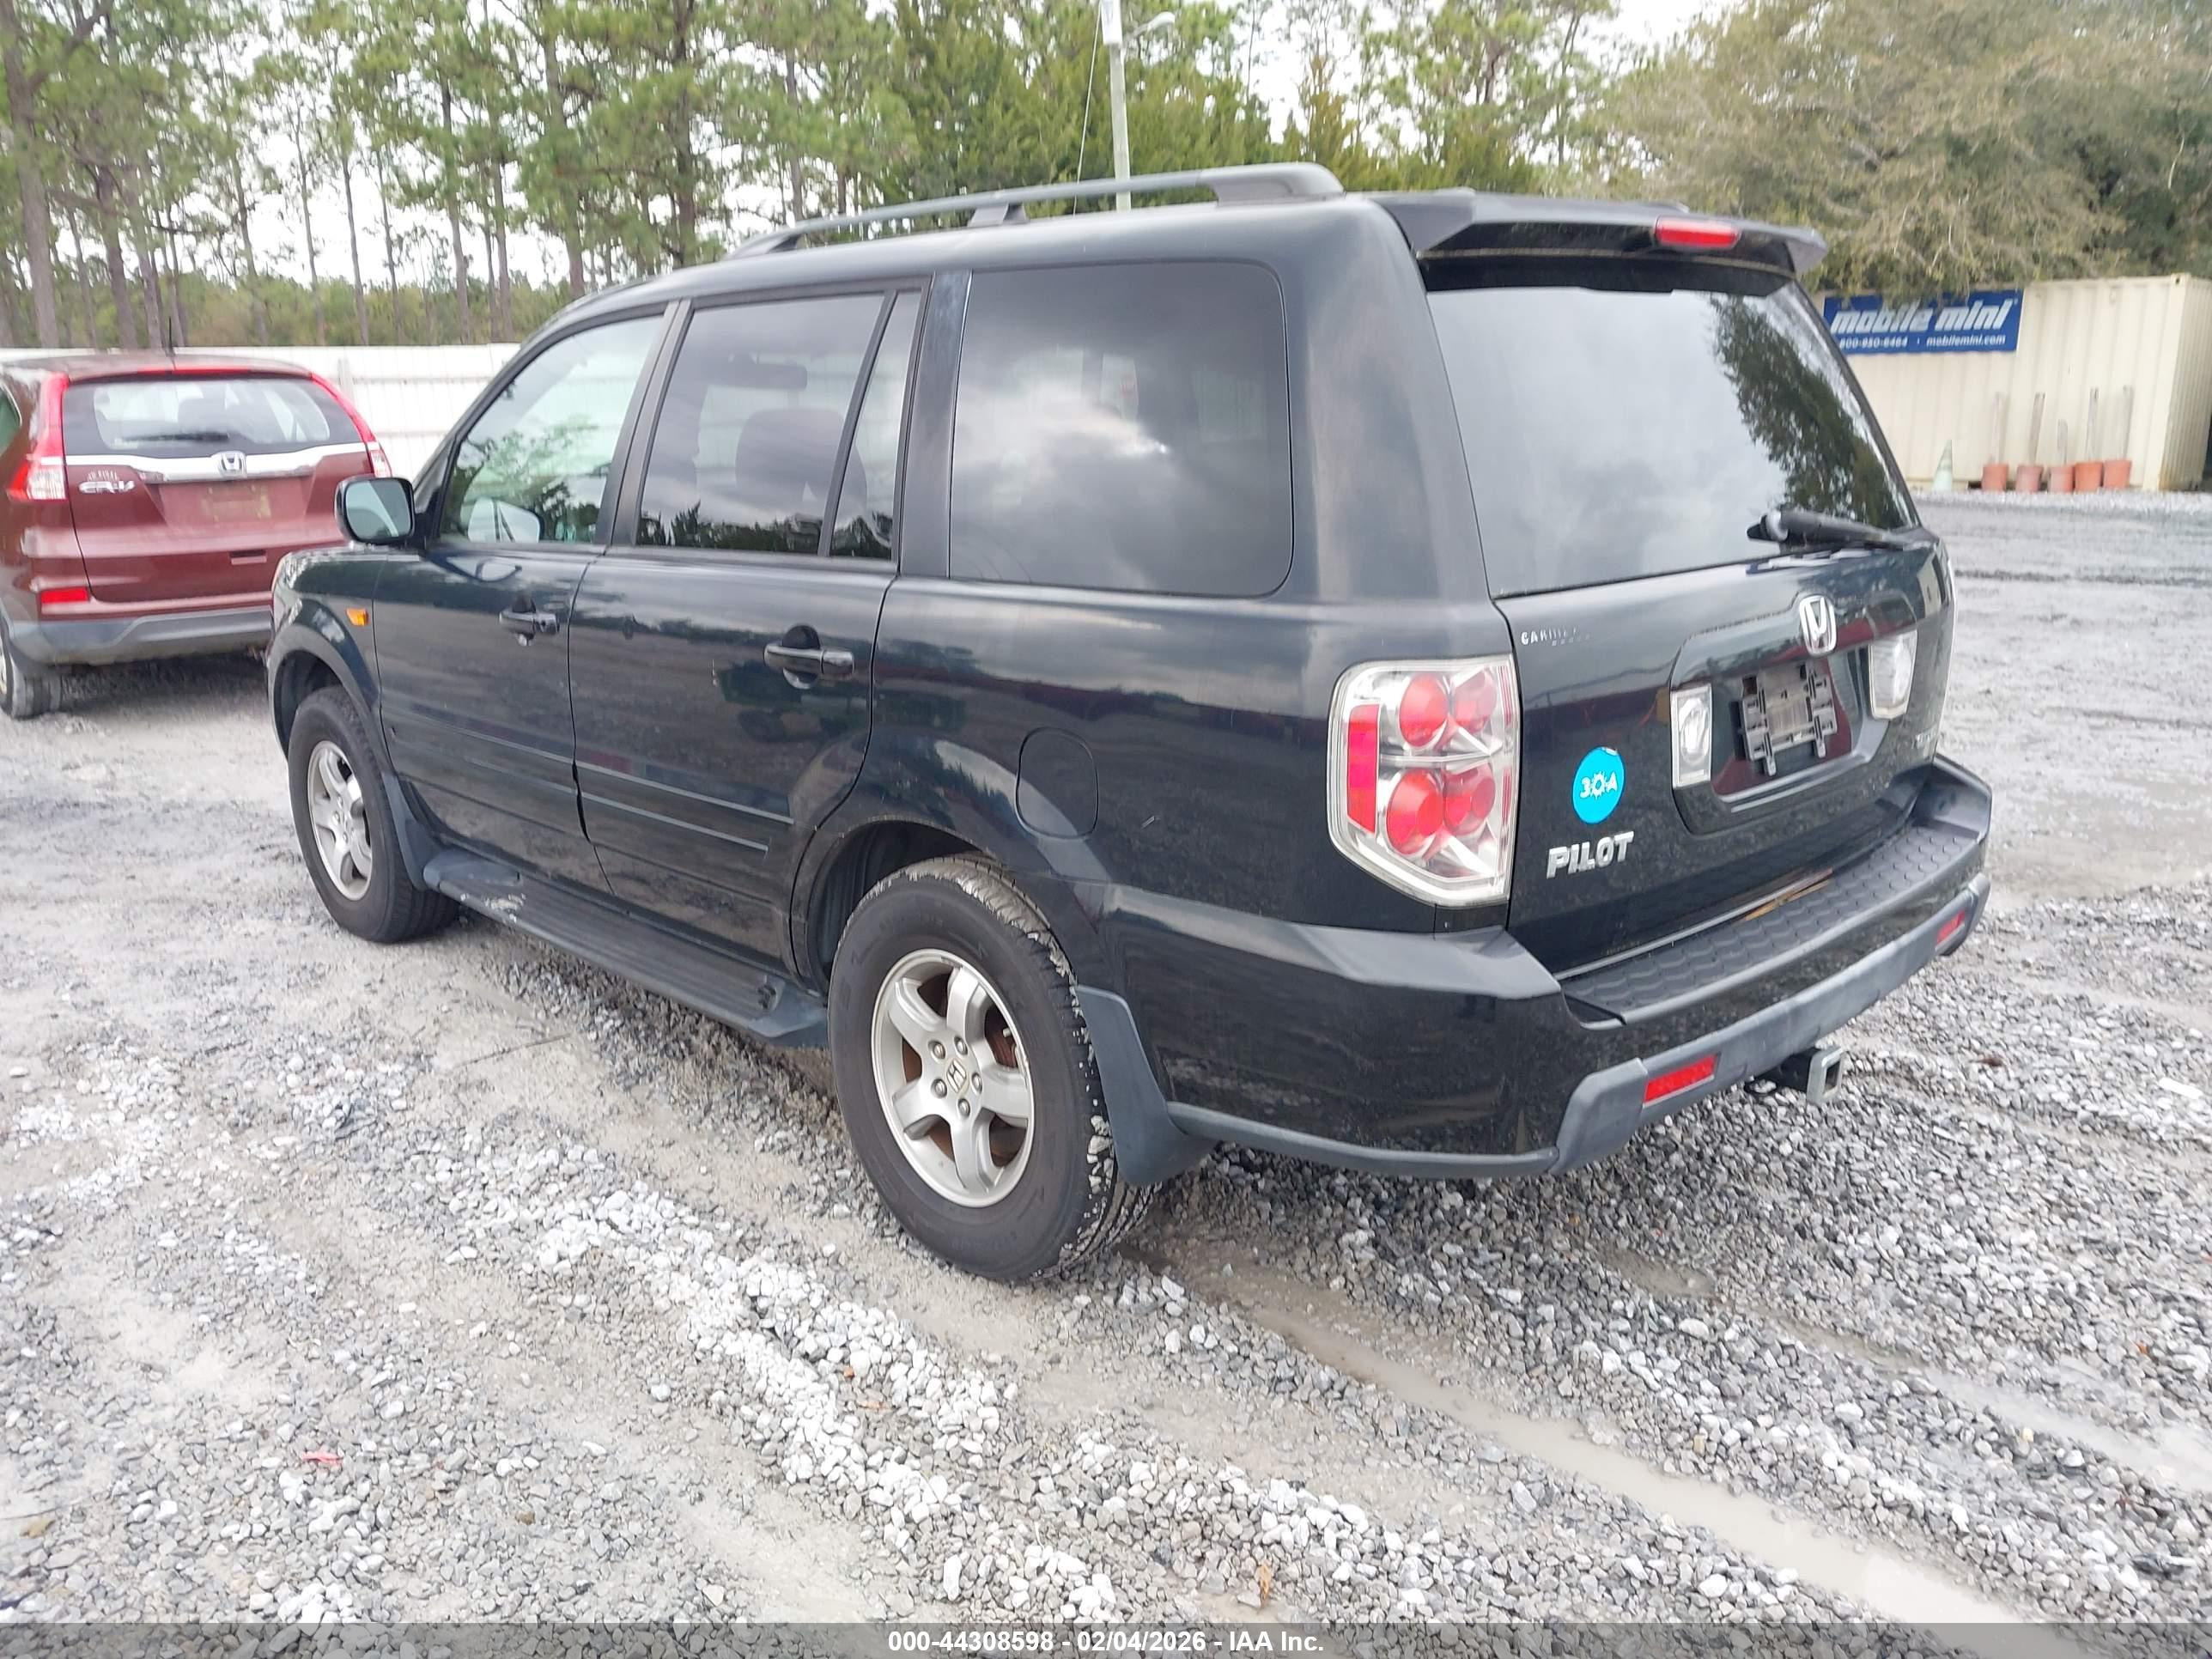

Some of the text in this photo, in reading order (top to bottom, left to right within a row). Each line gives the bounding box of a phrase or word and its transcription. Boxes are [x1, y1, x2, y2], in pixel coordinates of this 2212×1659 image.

[1935, 298, 2013, 331] mini
[1926, 333, 2006, 348] mobilemini.com
[1546, 830, 1634, 879] PILOT
